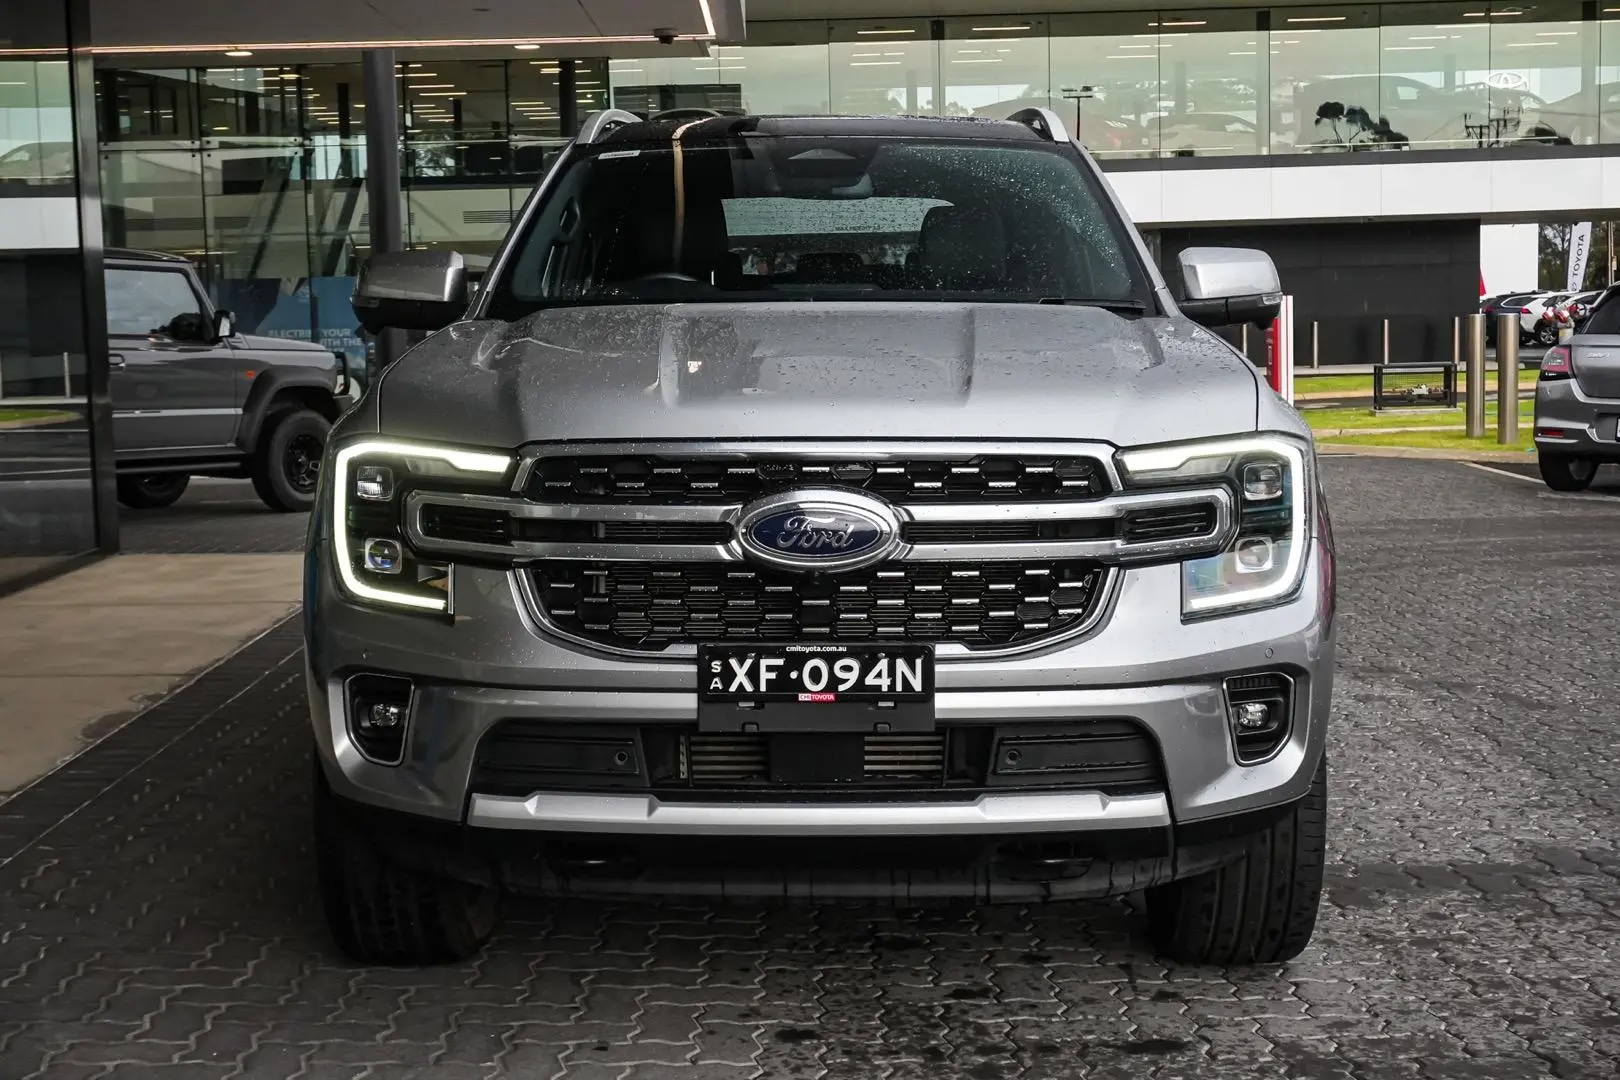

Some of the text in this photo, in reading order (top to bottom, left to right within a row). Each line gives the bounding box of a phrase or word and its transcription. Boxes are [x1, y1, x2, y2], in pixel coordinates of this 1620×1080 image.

[1572, 234, 1585, 277] TOYOTA
[776, 515, 855, 549] Ford
[785, 645, 847, 654] cmitoyota.com.au
